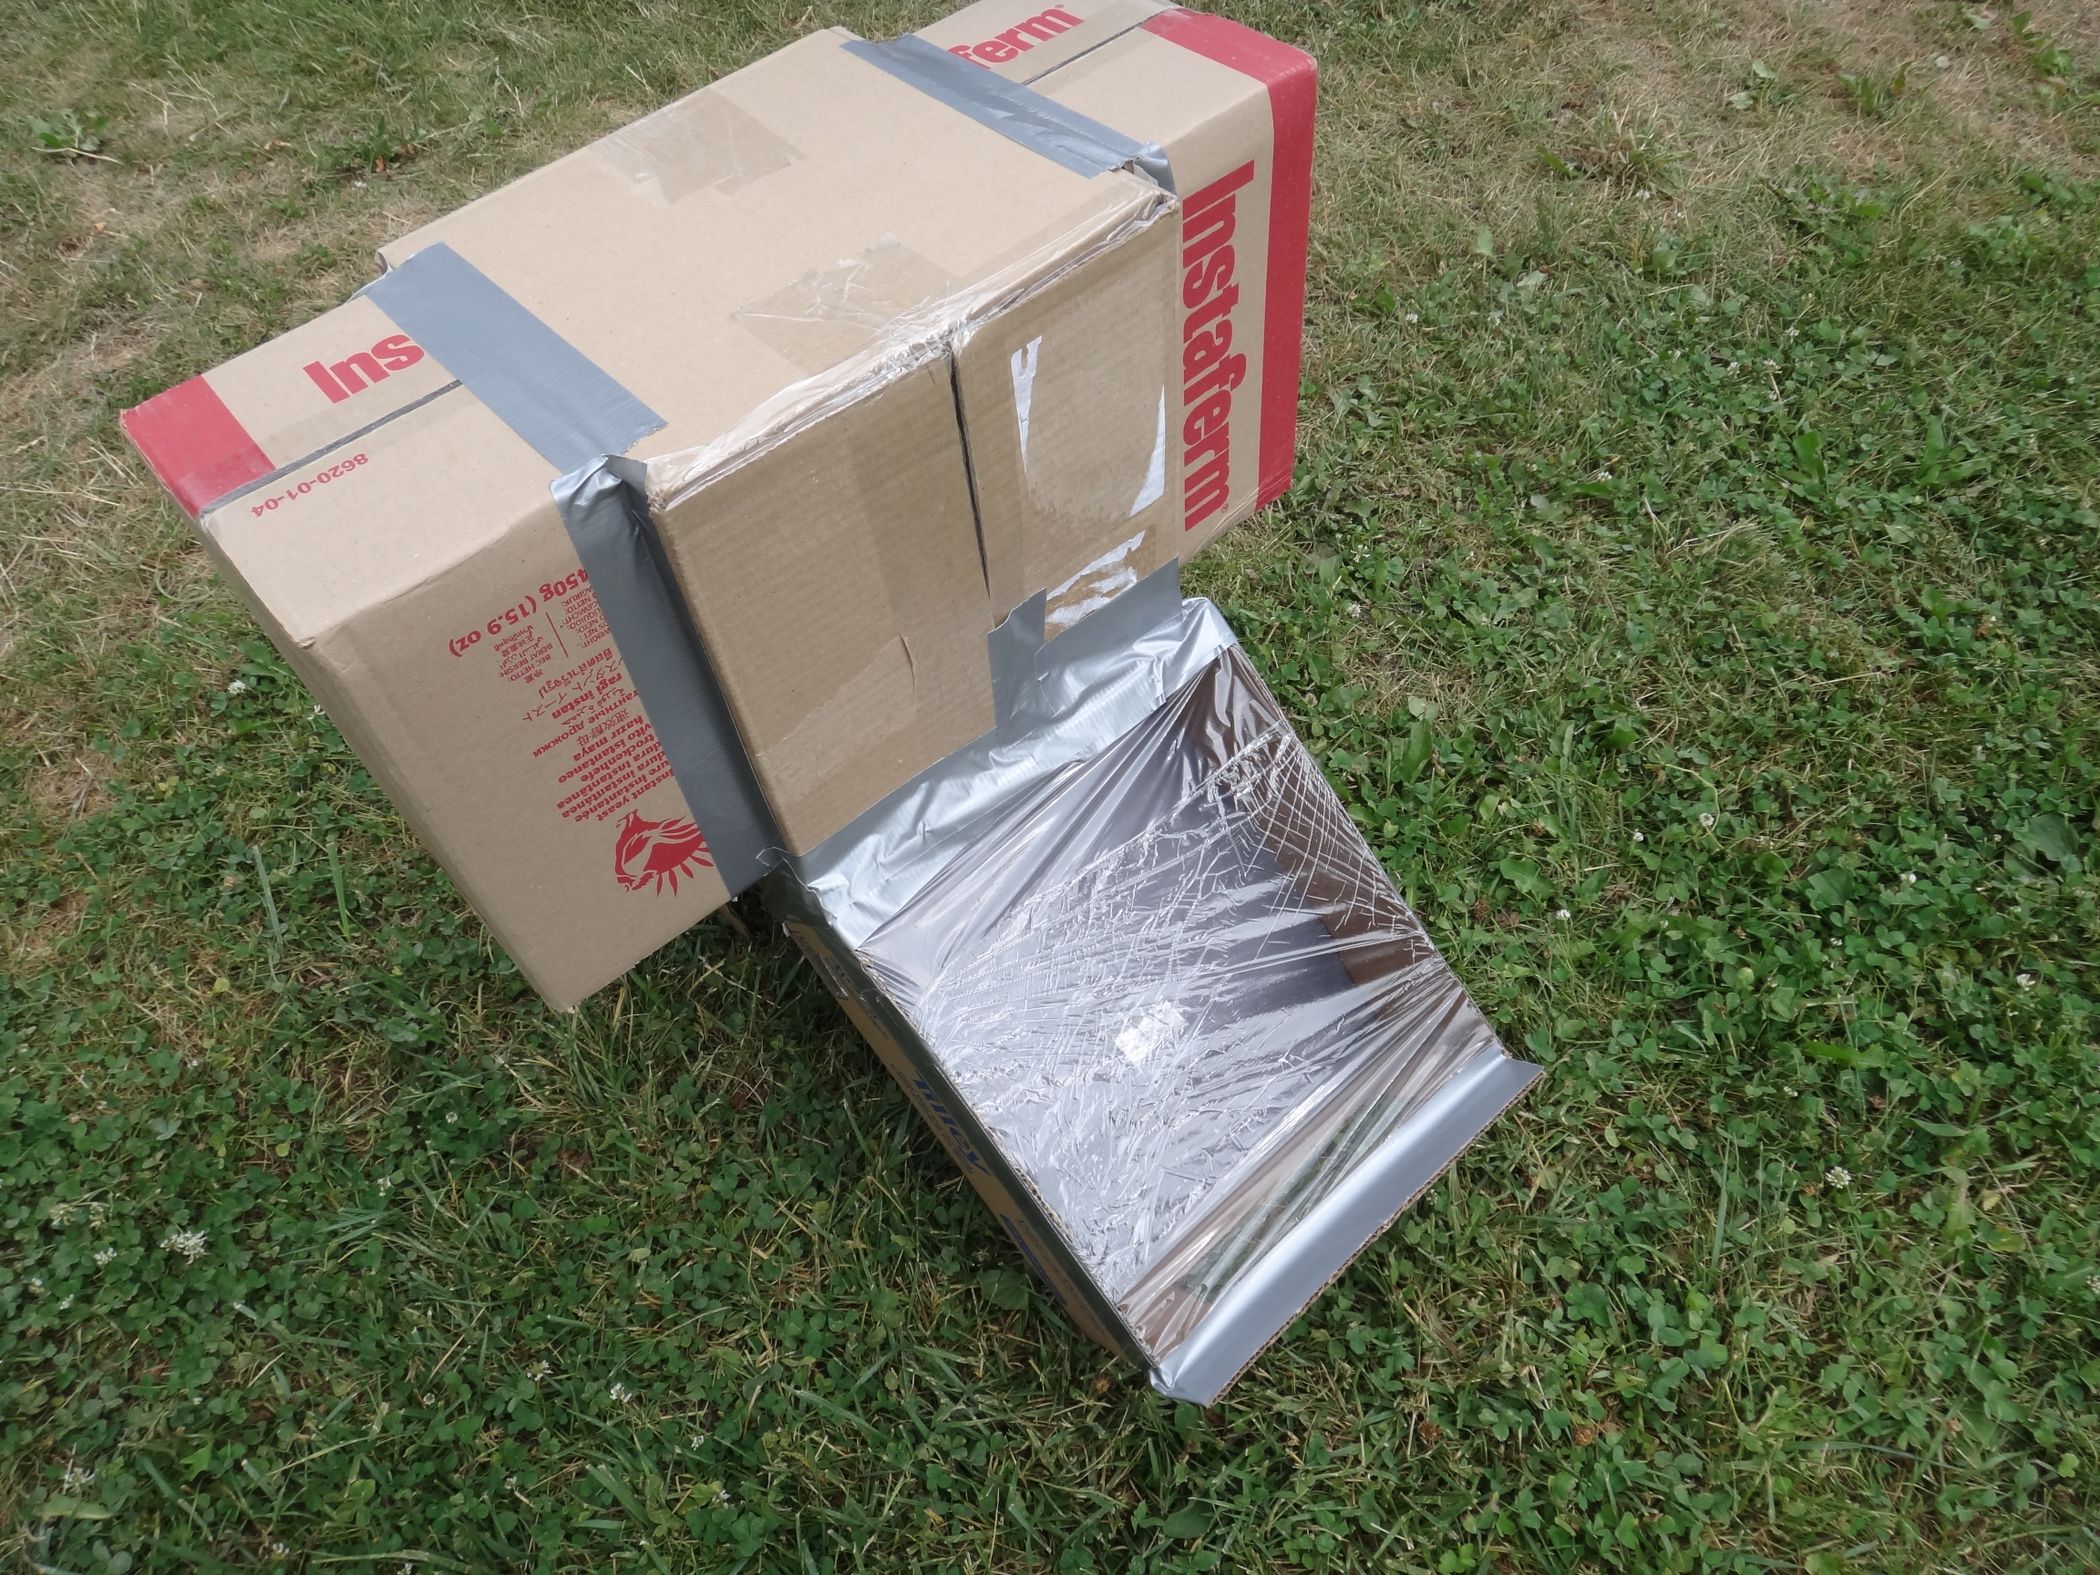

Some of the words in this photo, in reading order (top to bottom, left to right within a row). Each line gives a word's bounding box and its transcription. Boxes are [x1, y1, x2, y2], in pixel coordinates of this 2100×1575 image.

[305, 334, 425, 404] Ins
[249, 453, 368, 516] 8620-01-04
[486, 595, 537, 635] (15.9
[448, 630, 482, 658] oz)
[595, 672, 623, 696] ragi
[551, 689, 596, 720] instan
[532, 720, 585, 758] дрожжи
[572, 736, 609, 762] maya
[627, 723, 652, 741] vito
[558, 738, 627, 784] istantaneo
[580, 733, 655, 783] trockenhefe
[556, 760, 632, 810] instantânea
[561, 769, 636, 819] instantánea
[574, 773, 648, 823] instantanée
[595, 795, 631, 822] yeast
